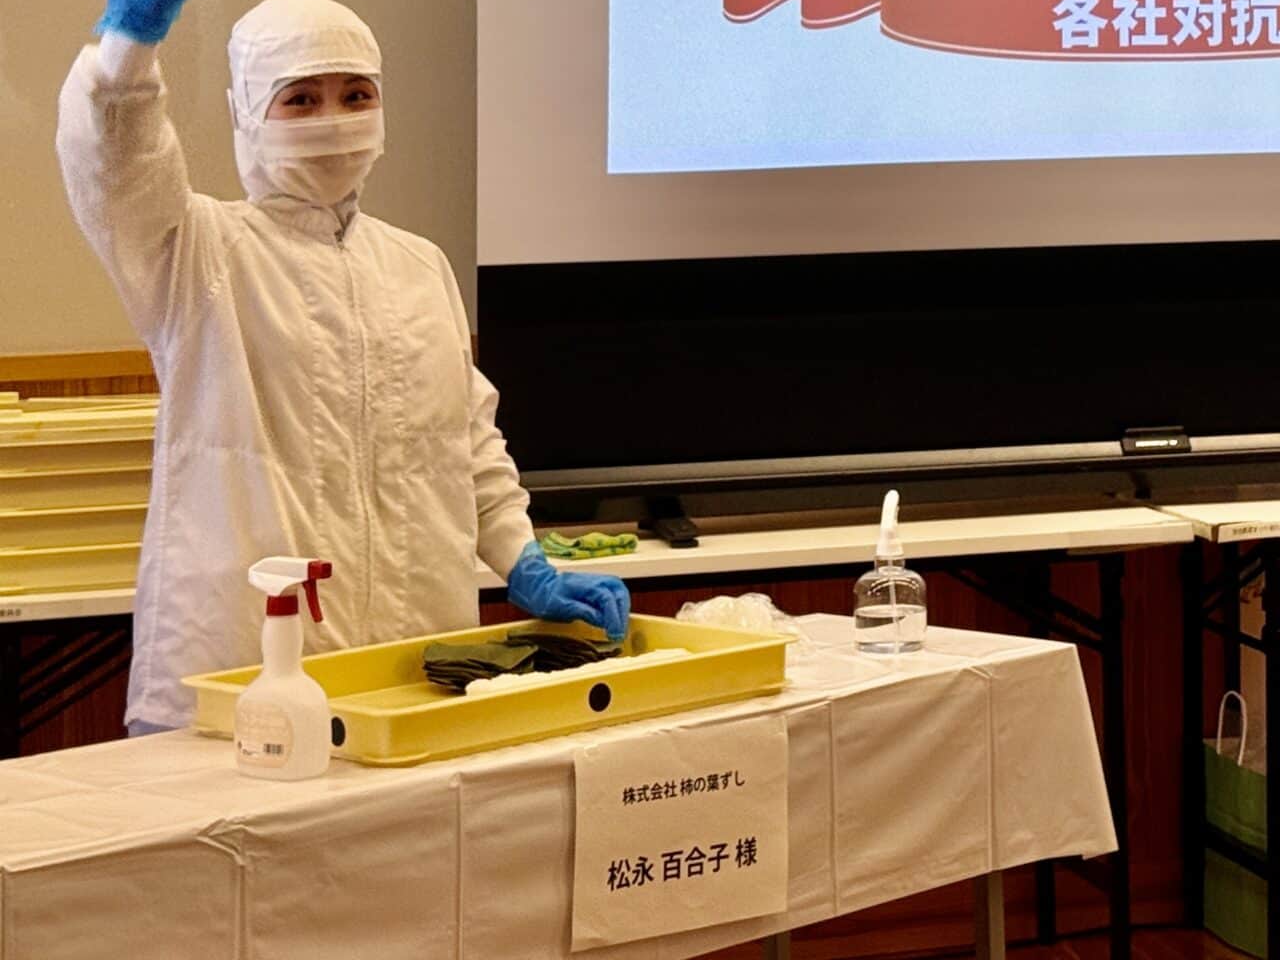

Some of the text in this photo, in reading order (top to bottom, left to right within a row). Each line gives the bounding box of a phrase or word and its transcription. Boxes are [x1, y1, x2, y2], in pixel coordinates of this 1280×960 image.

[622, 770, 745, 806] 株式会社 柿の葉ずし
[607, 836, 758, 892] 松永 百合子 様
